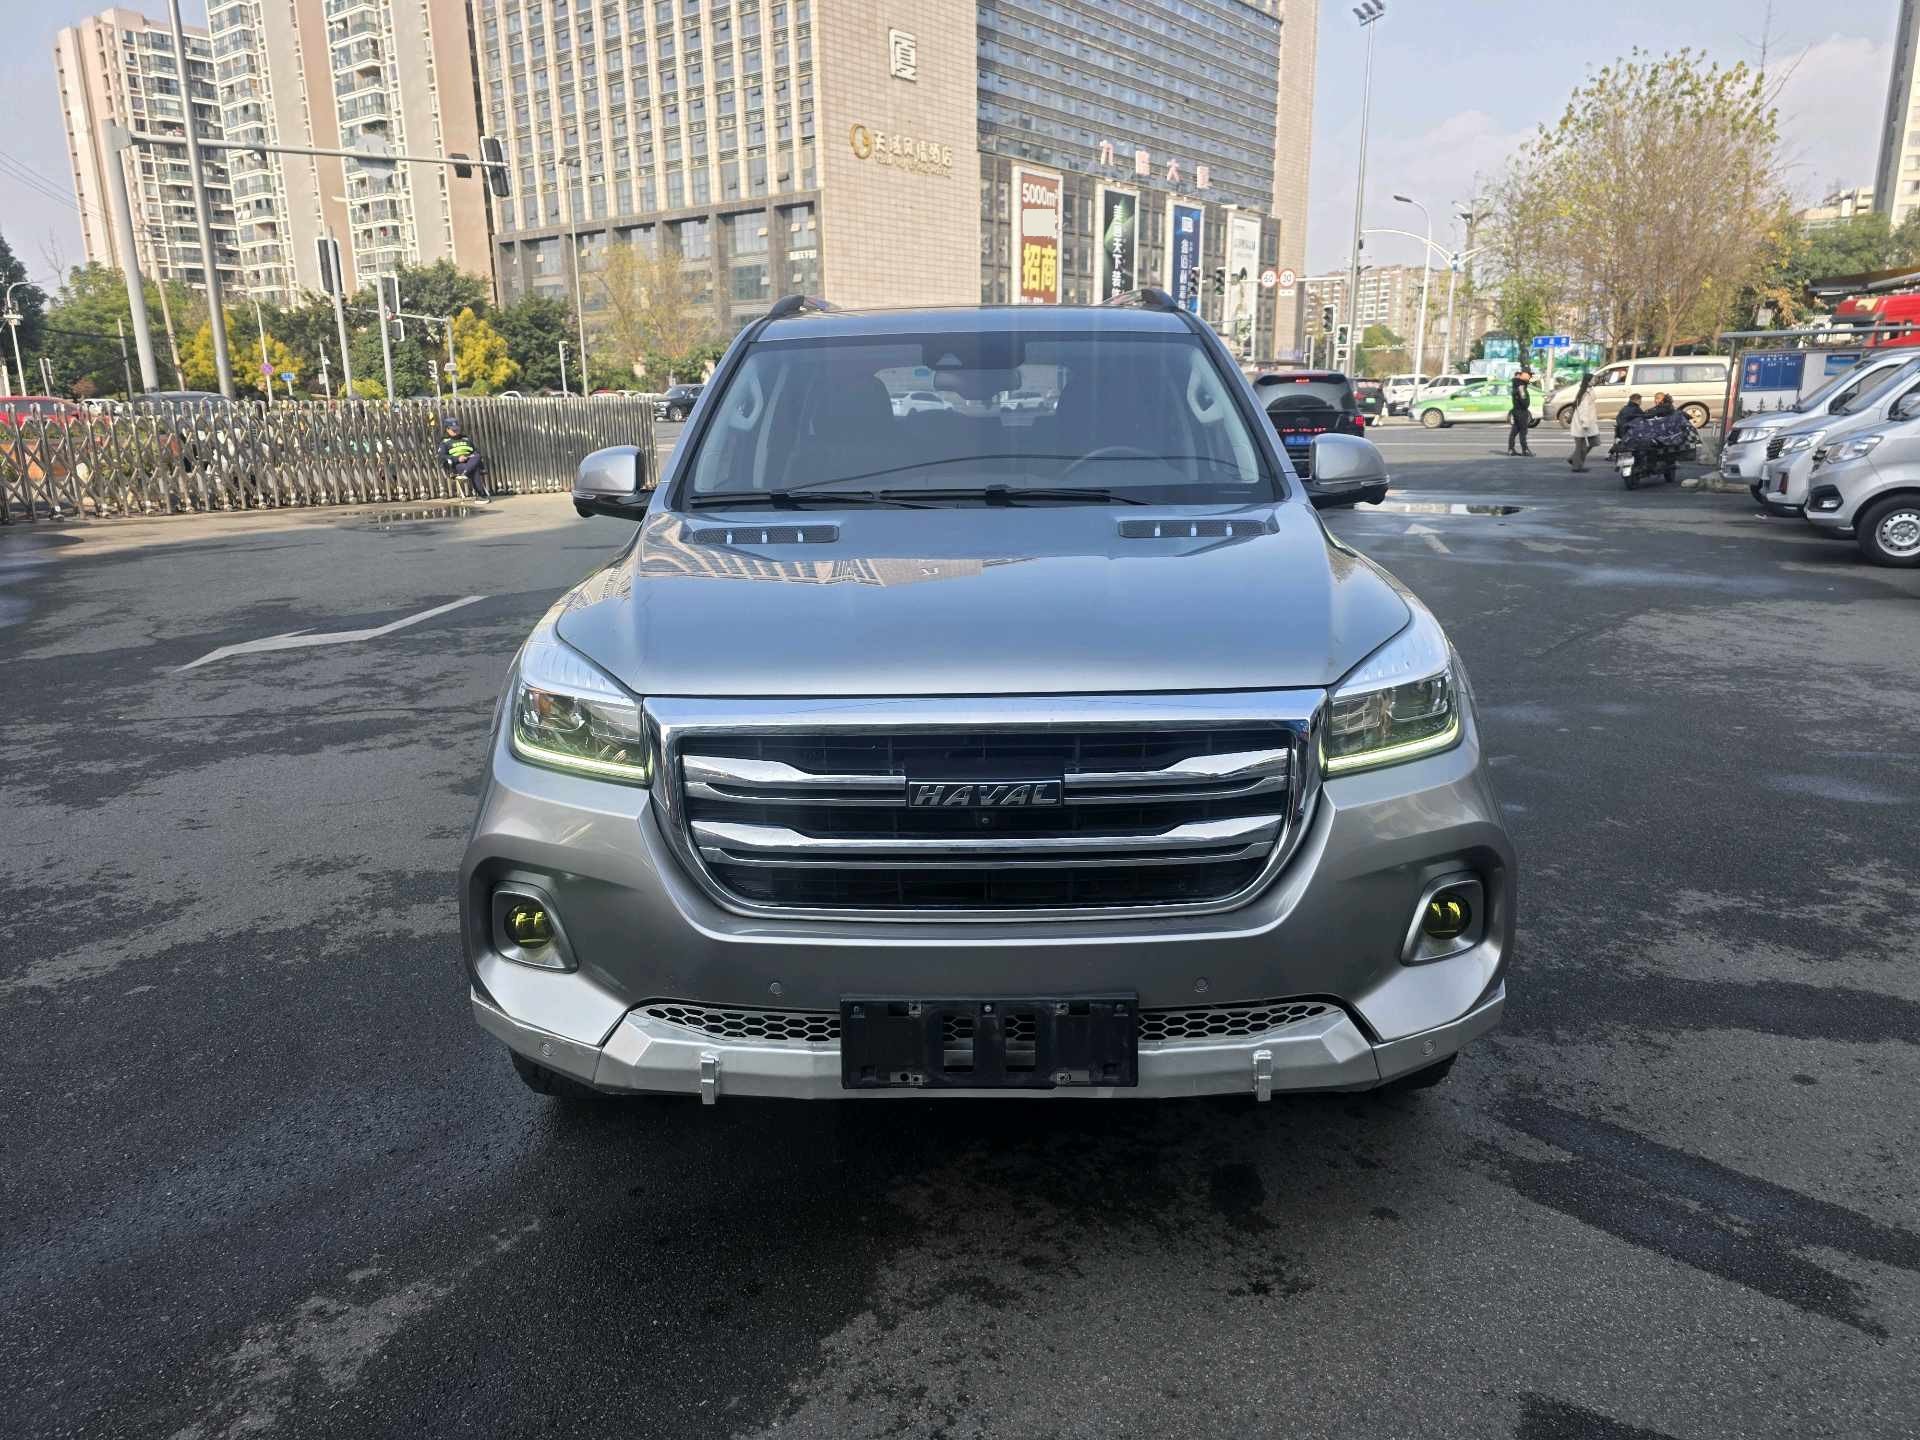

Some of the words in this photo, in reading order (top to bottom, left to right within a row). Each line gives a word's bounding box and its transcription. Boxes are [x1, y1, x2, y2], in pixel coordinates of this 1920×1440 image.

[889, 28, 917, 83] 厦
[1023, 243, 1057, 292] 招商
[913, 784, 1057, 806] HAVAL
